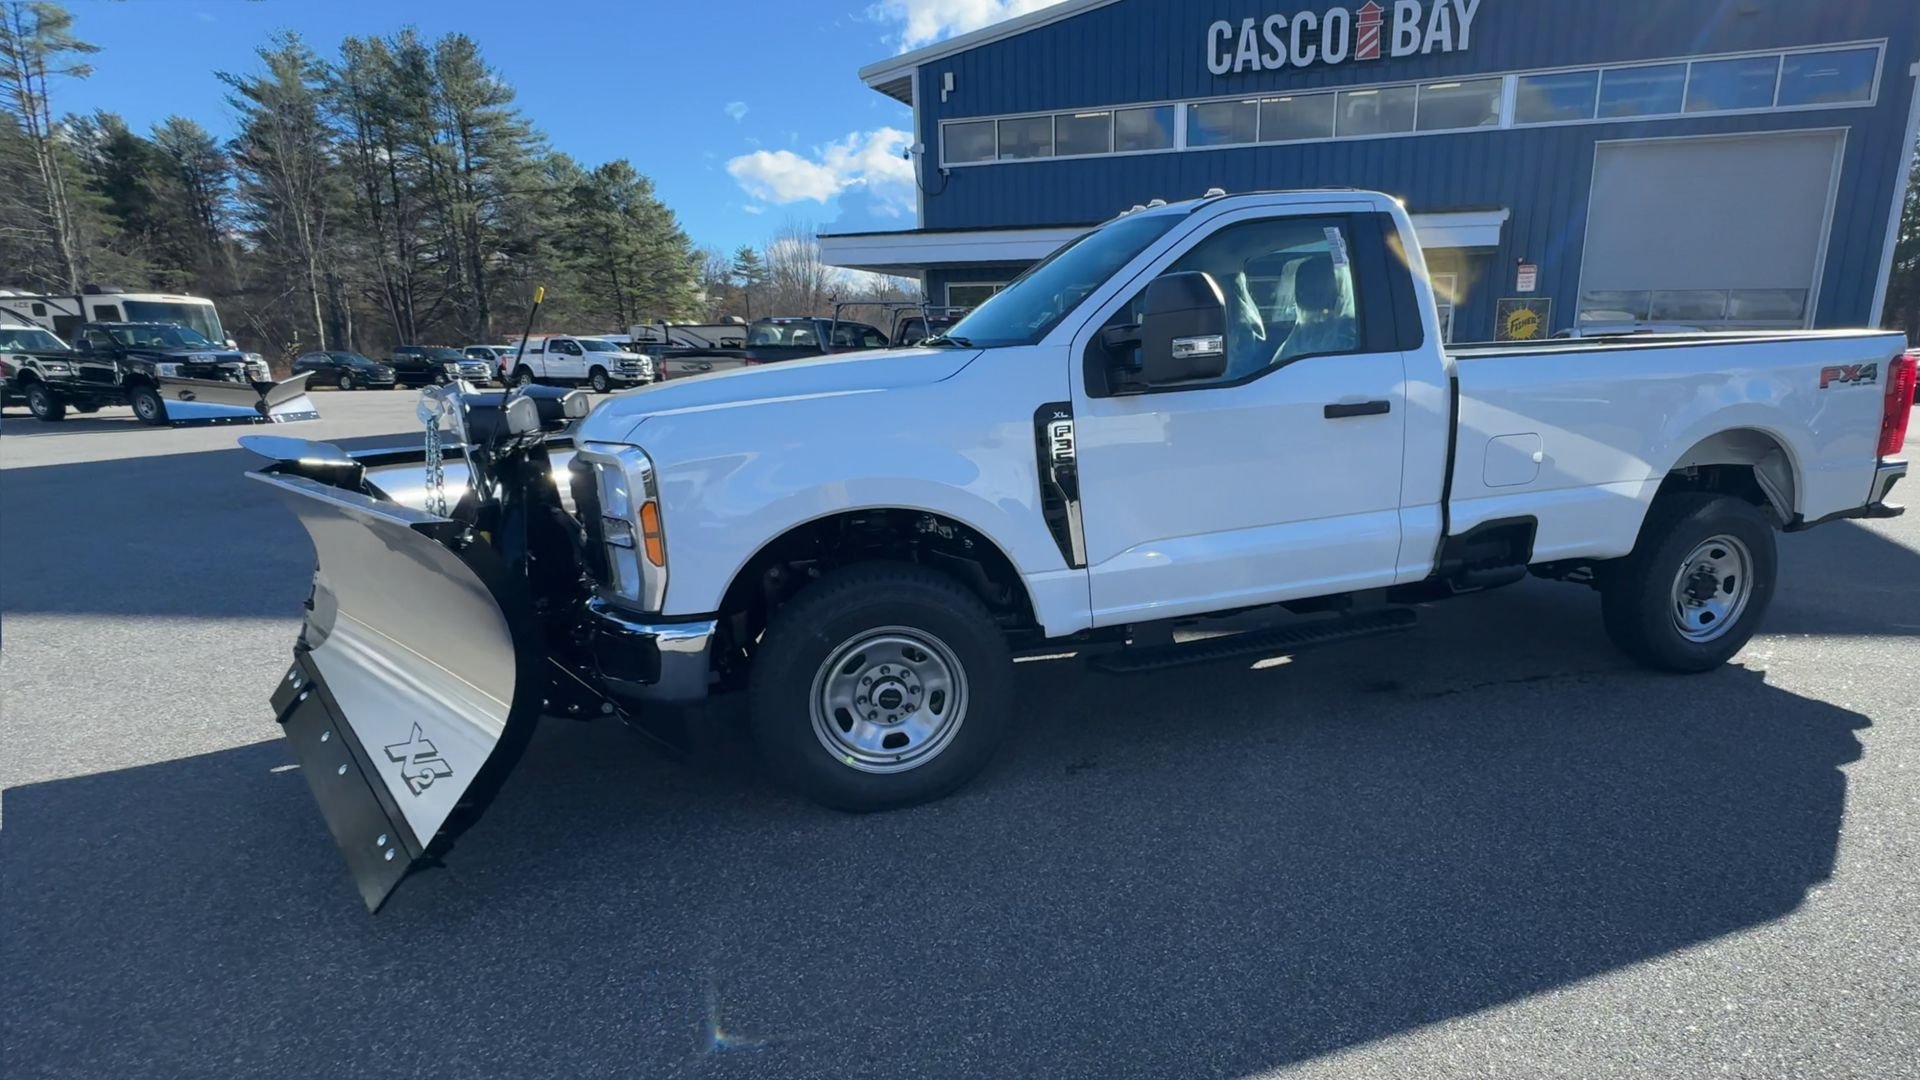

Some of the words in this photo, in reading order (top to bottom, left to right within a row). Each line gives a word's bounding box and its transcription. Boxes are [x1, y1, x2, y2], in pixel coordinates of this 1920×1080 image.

[1207, 7, 1350, 75] CASCO
[1390, 0, 1480, 57] BAY
[1819, 362, 1878, 389] FX4
[1053, 411, 1069, 419] XL
